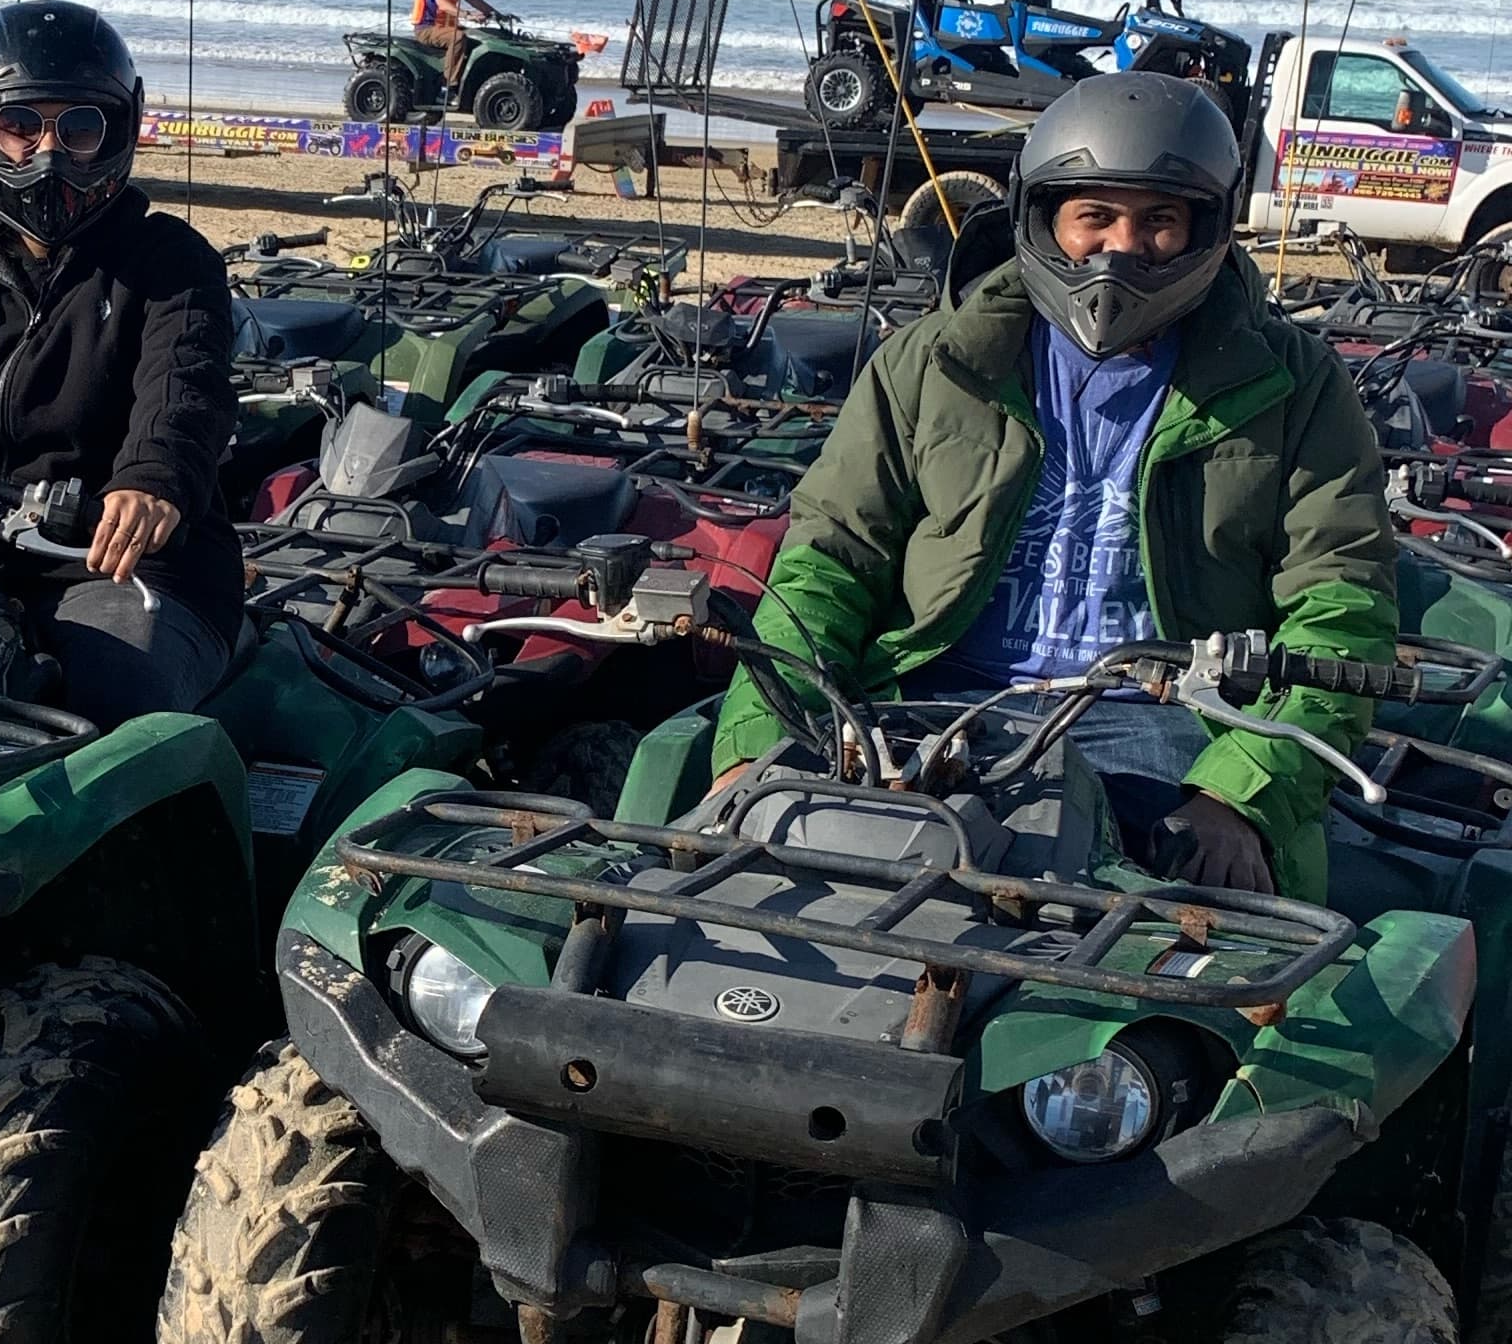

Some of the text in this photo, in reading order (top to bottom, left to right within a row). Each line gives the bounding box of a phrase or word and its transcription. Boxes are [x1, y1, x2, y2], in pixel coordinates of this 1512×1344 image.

[1281, 156, 1358, 171] ADVENTURE
[1363, 160, 1414, 174] STARTS
[1071, 542, 1145, 577] BETT
[1052, 578, 1068, 595] IN
[998, 575, 1149, 644] VALLEY
[1002, 637, 1029, 652] DEATH
[1062, 646, 1102, 663] NATIONA
